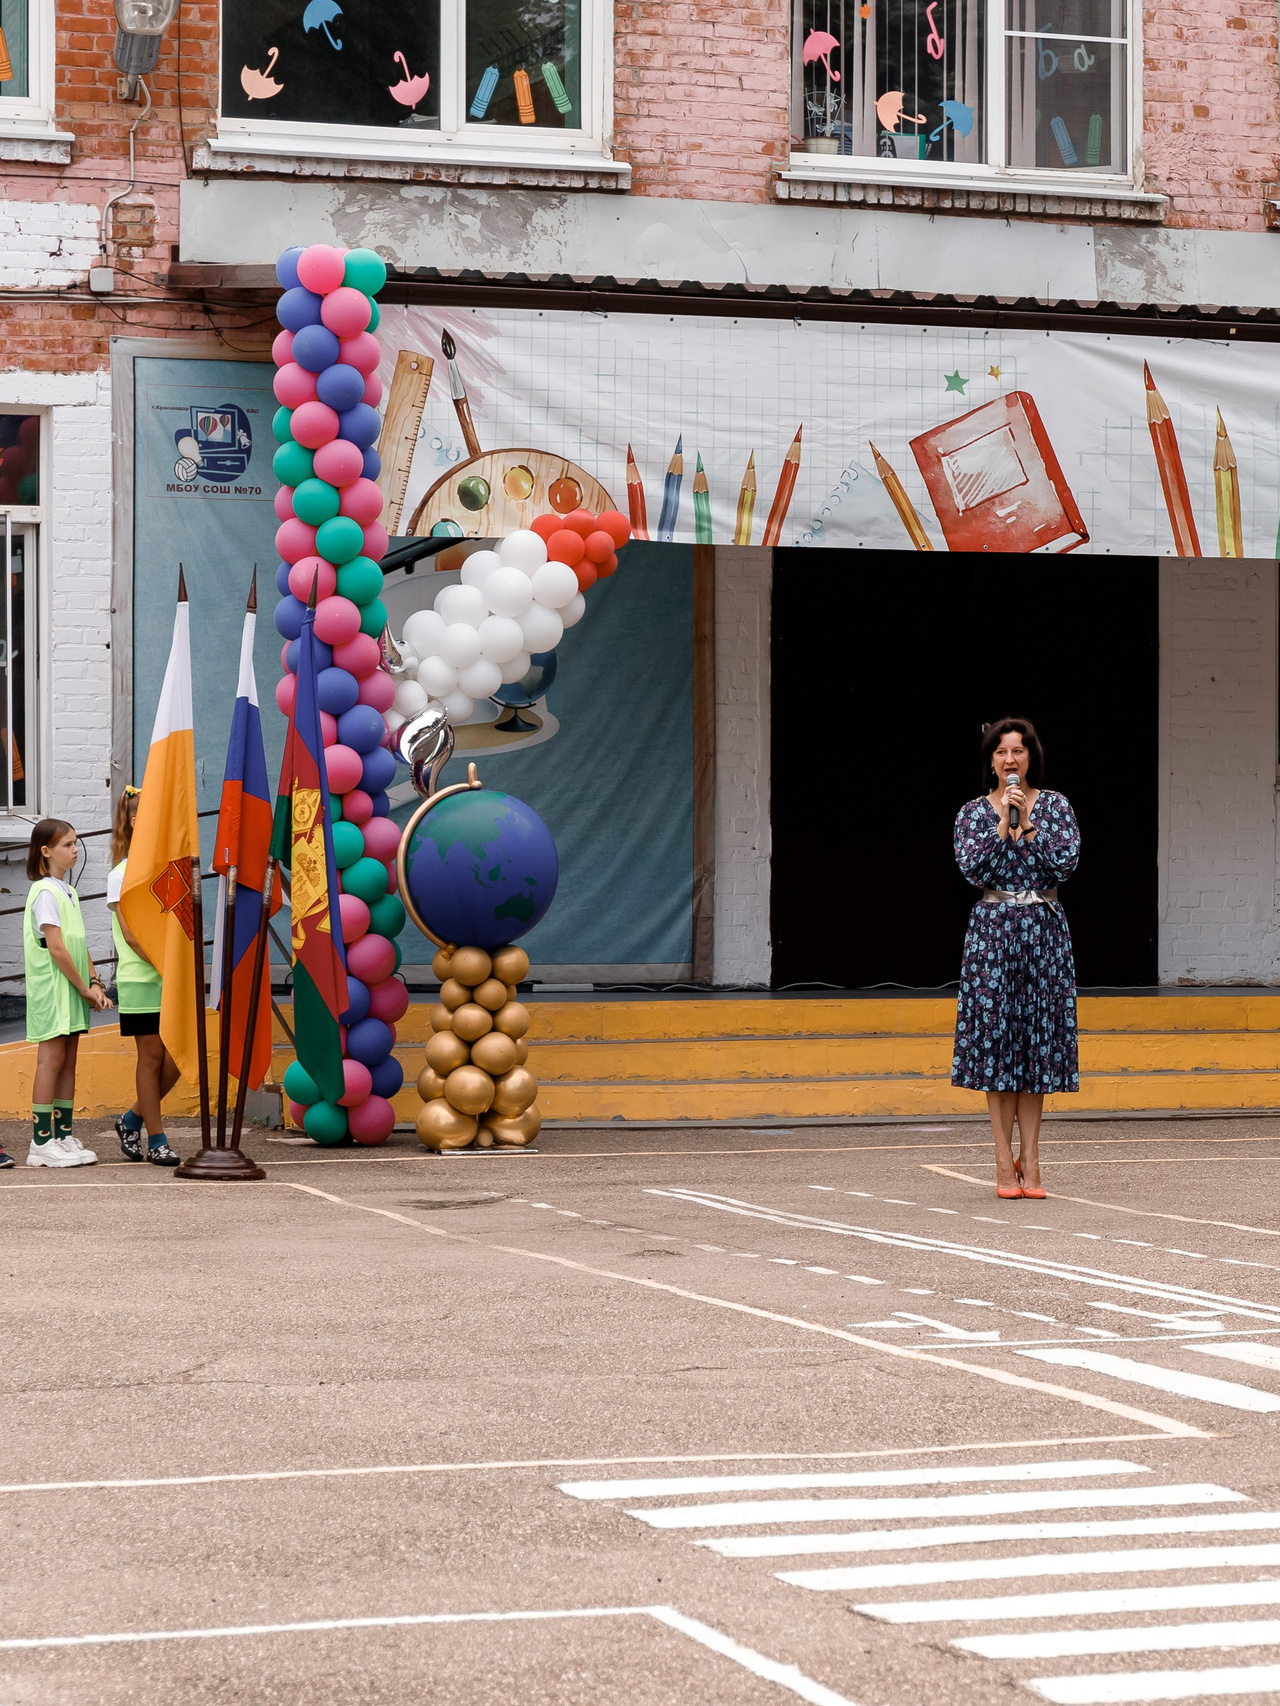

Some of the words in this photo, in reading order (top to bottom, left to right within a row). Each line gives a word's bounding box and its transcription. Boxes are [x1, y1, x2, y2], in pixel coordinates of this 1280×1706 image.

[166, 483, 200, 493] МБОУ
[202, 485, 231, 494] СОШ
[234, 486, 262, 495] №70
